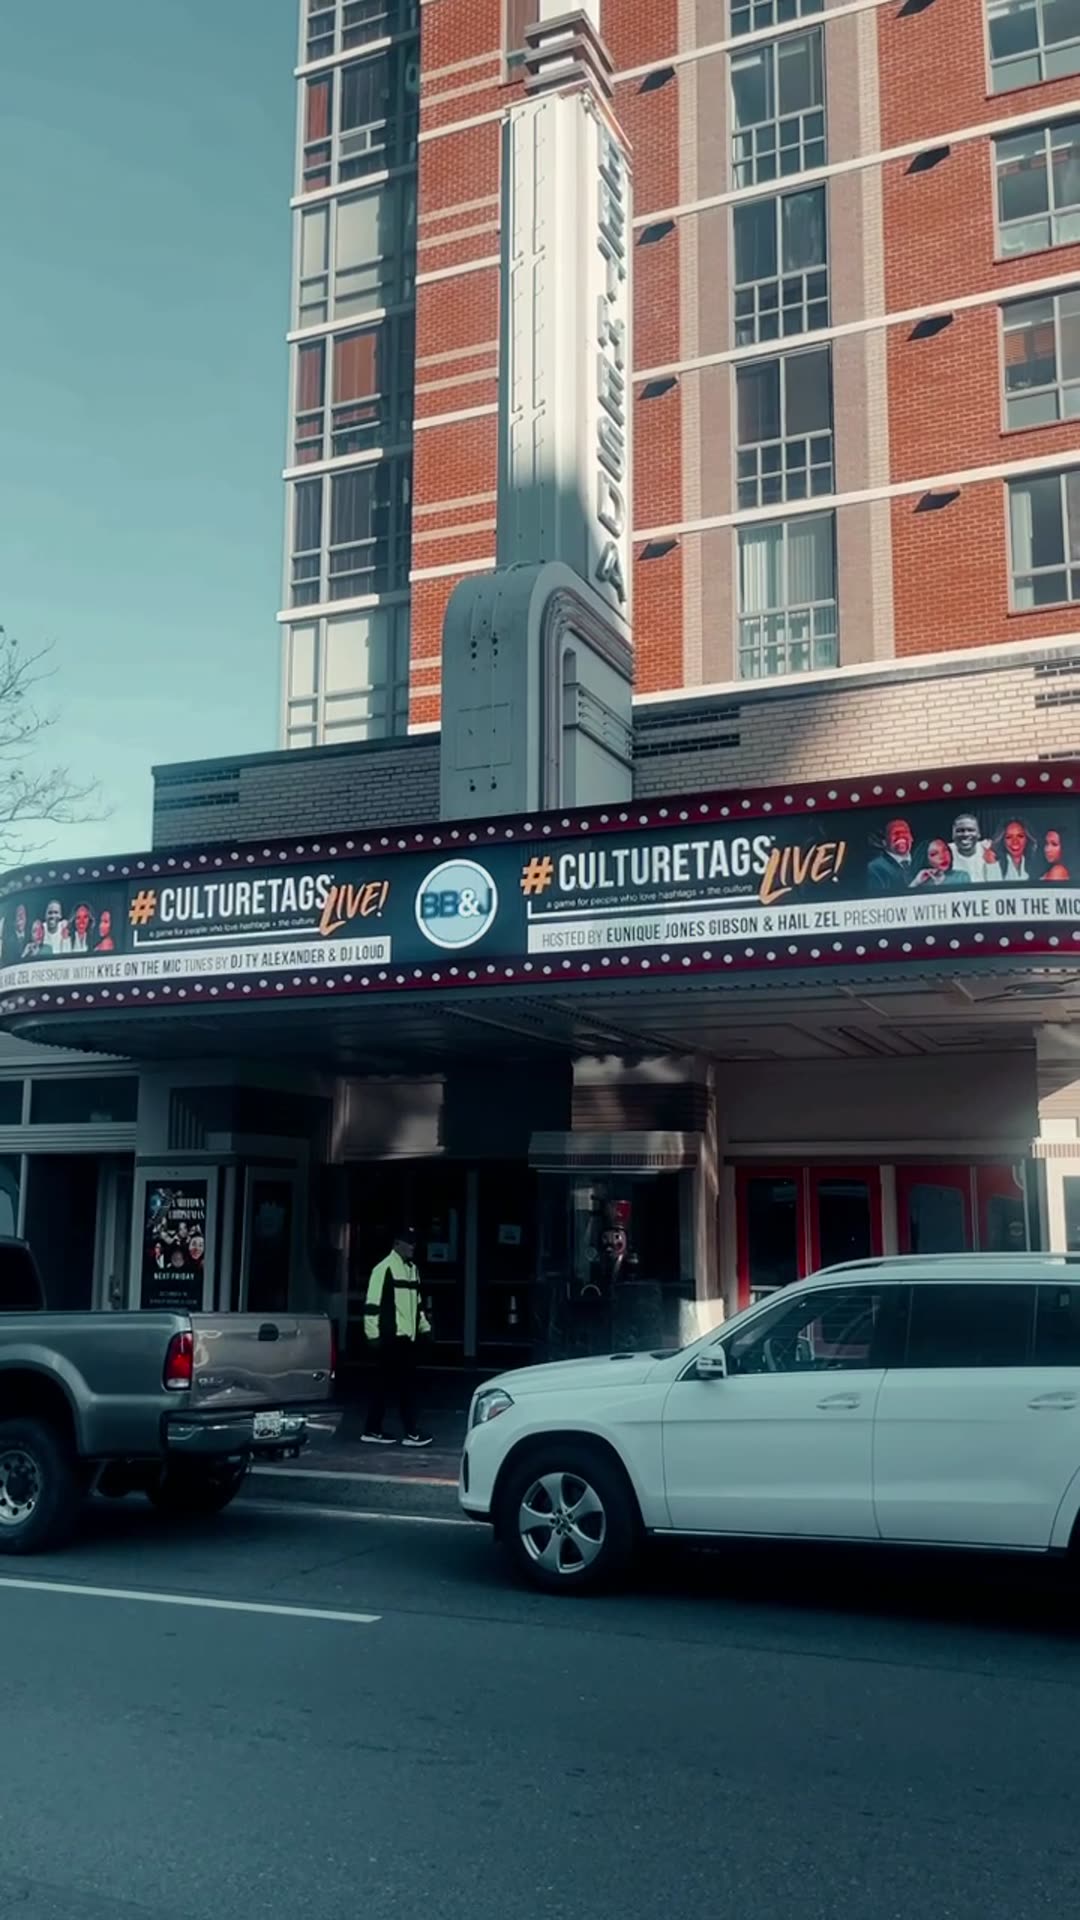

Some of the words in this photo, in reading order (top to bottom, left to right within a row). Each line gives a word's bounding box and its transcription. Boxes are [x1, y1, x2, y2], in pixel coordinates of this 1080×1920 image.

[597, 122, 625, 604] BETHESDA
[520, 834, 771, 895] #CULTURETAGS
[760, 841, 846, 905] LIVE!
[129, 874, 330, 925] #CULTURETAGS
[320, 881, 389, 936] LIVE!
[420, 888, 493, 919] BB&J
[542, 930, 585, 947] HOSTED
[588, 929, 603, 945] BY
[606, 923, 661, 943] EUNIQUE
[664, 920, 705, 938] JONES
[708, 916, 758, 936] GIBSON
[763, 915, 773, 932] &
[778, 913, 809, 931] HAIL
[815, 911, 840, 928] ZEL
[843, 906, 908, 927] PRESHOW
[914, 903, 947, 921] WITH
[951, 899, 989, 918] KYLE
[995, 898, 1016, 916] ON
[1021, 897, 1049, 915] THE
[1055, 897, 1080, 914] MIC
[553, 899, 576, 910] game
[577, 897, 589, 907] for
[590, 895, 619, 907] people
[620, 893, 638, 903] who
[640, 891, 657, 902] love
[658, 887, 697, 900] hashtags
[722, 884, 753, 894] culture
[97, 962, 120, 978] KYLE
[124, 961, 138, 976] ON
[140, 960, 159, 975] THE
[162, 958, 181, 974] MIC
[185, 956, 213, 972] TUNES
[215, 956, 228, 970] BY
[230, 954, 243, 969] DJ
[245, 953, 258, 967] TY
[261, 948, 325, 967] ALEXANDER
[328, 948, 336, 962] &
[340, 946, 353, 962] DJ
[356, 944, 385, 960] LOUD
